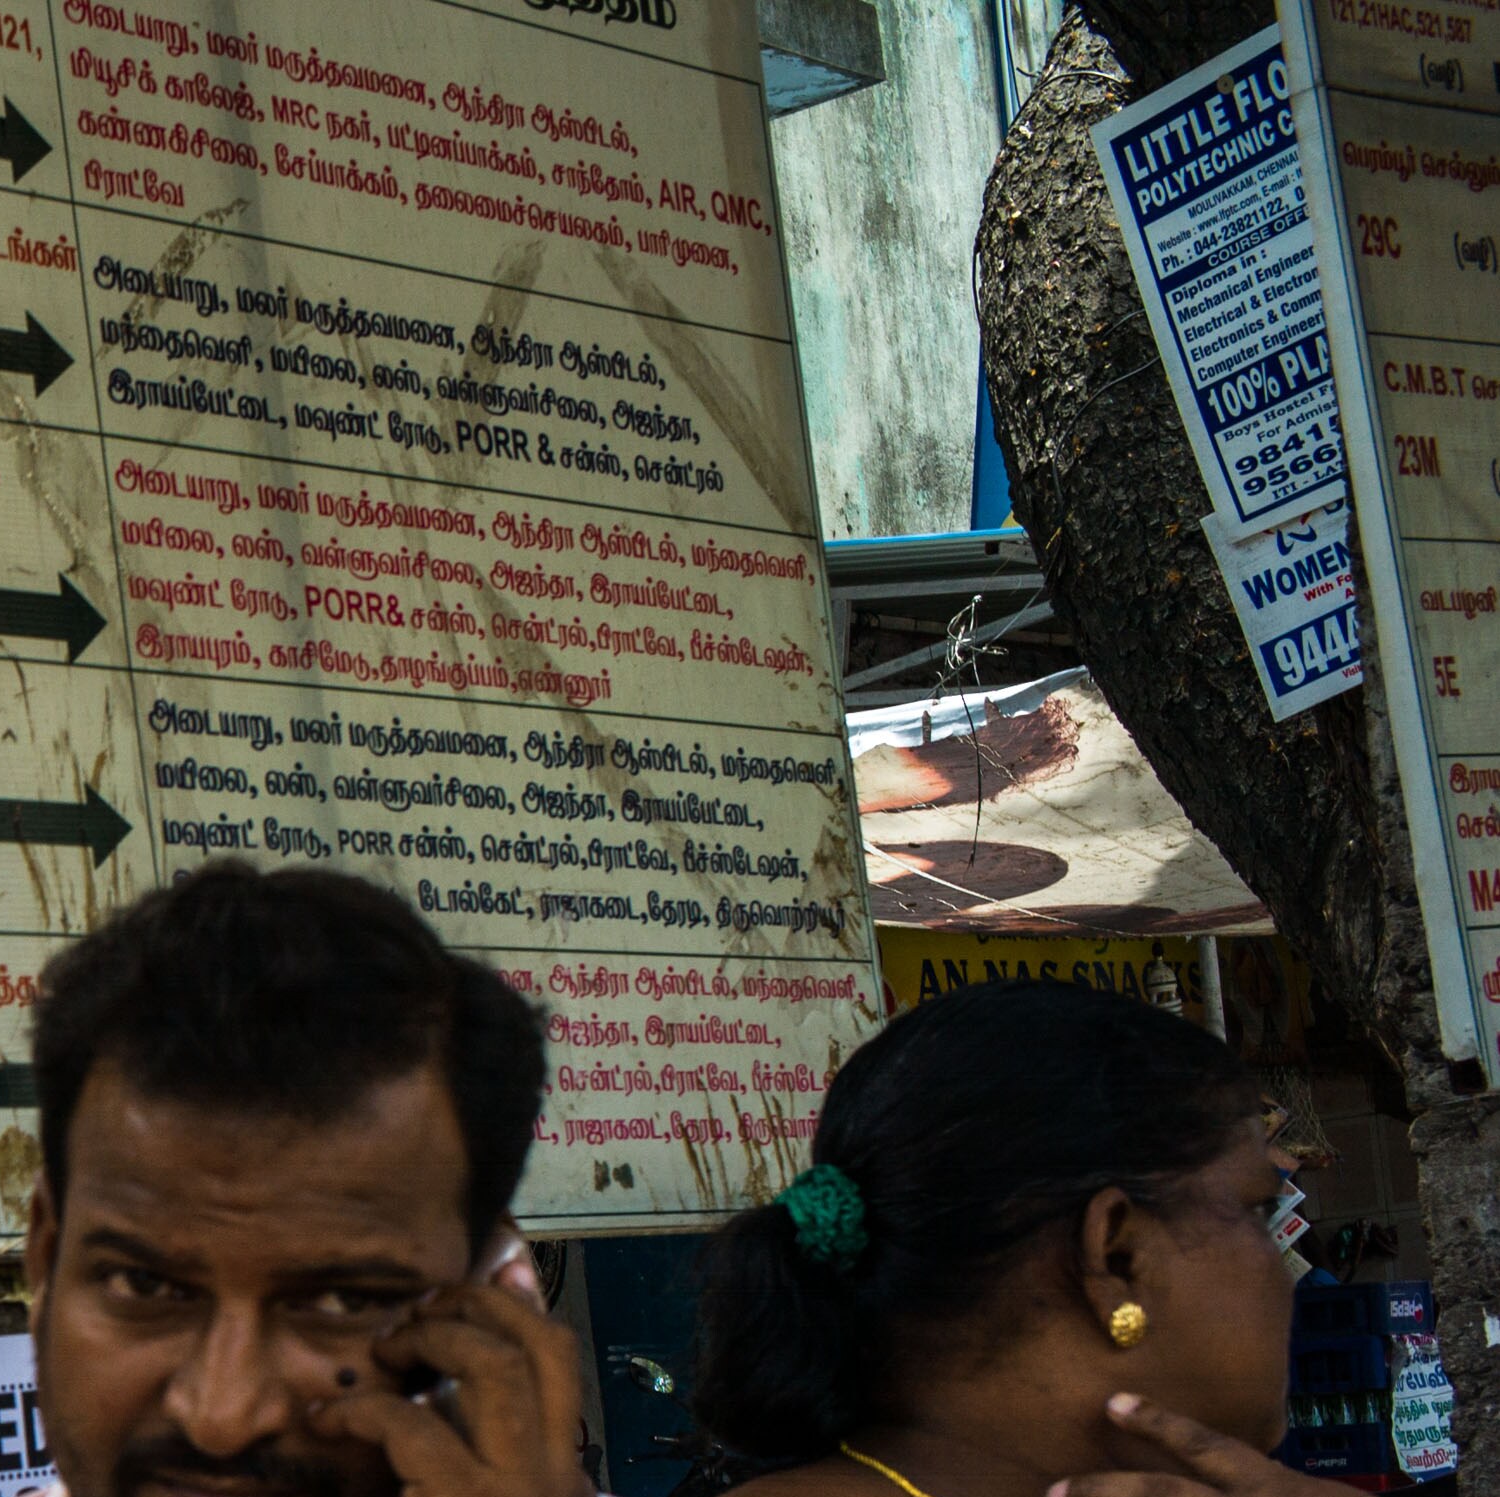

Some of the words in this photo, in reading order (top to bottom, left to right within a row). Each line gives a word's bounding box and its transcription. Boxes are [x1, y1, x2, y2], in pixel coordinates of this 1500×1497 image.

[206, 29, 259, 65] மலர்
[271, 95, 320, 131] MRC
[1124, 94, 1231, 183] LITTLE
[1136, 120, 1275, 216] POLYTECHNIC
[1157, 229, 1192, 253] Website
[1262, 175, 1291, 198] E-mail
[1357, 213, 1402, 259] 29C
[1208, 224, 1271, 268] COURSE
[237, 286, 288, 321] மலர்
[1171, 264, 1238, 305] Diploma
[1177, 274, 1254, 324] Mechanical
[1184, 302, 1247, 343] Electrical
[1251, 295, 1262, 310] &
[1190, 319, 1265, 363] Electronics
[1267, 309, 1279, 325] &
[1197, 343, 1260, 382] Computer
[1208, 361, 1281, 424] 100%
[1223, 419, 1261, 443] Boys
[1264, 392, 1315, 422] Hostel
[1256, 425, 1281, 443] For
[456, 420, 531, 463] PORR
[538, 434, 556, 467] &
[1394, 433, 1441, 477] 23M
[257, 481, 309, 515] மலர்
[1303, 581, 1334, 602] With
[1433, 655, 1461, 697] 5E
[338, 830, 393, 855] PORR
